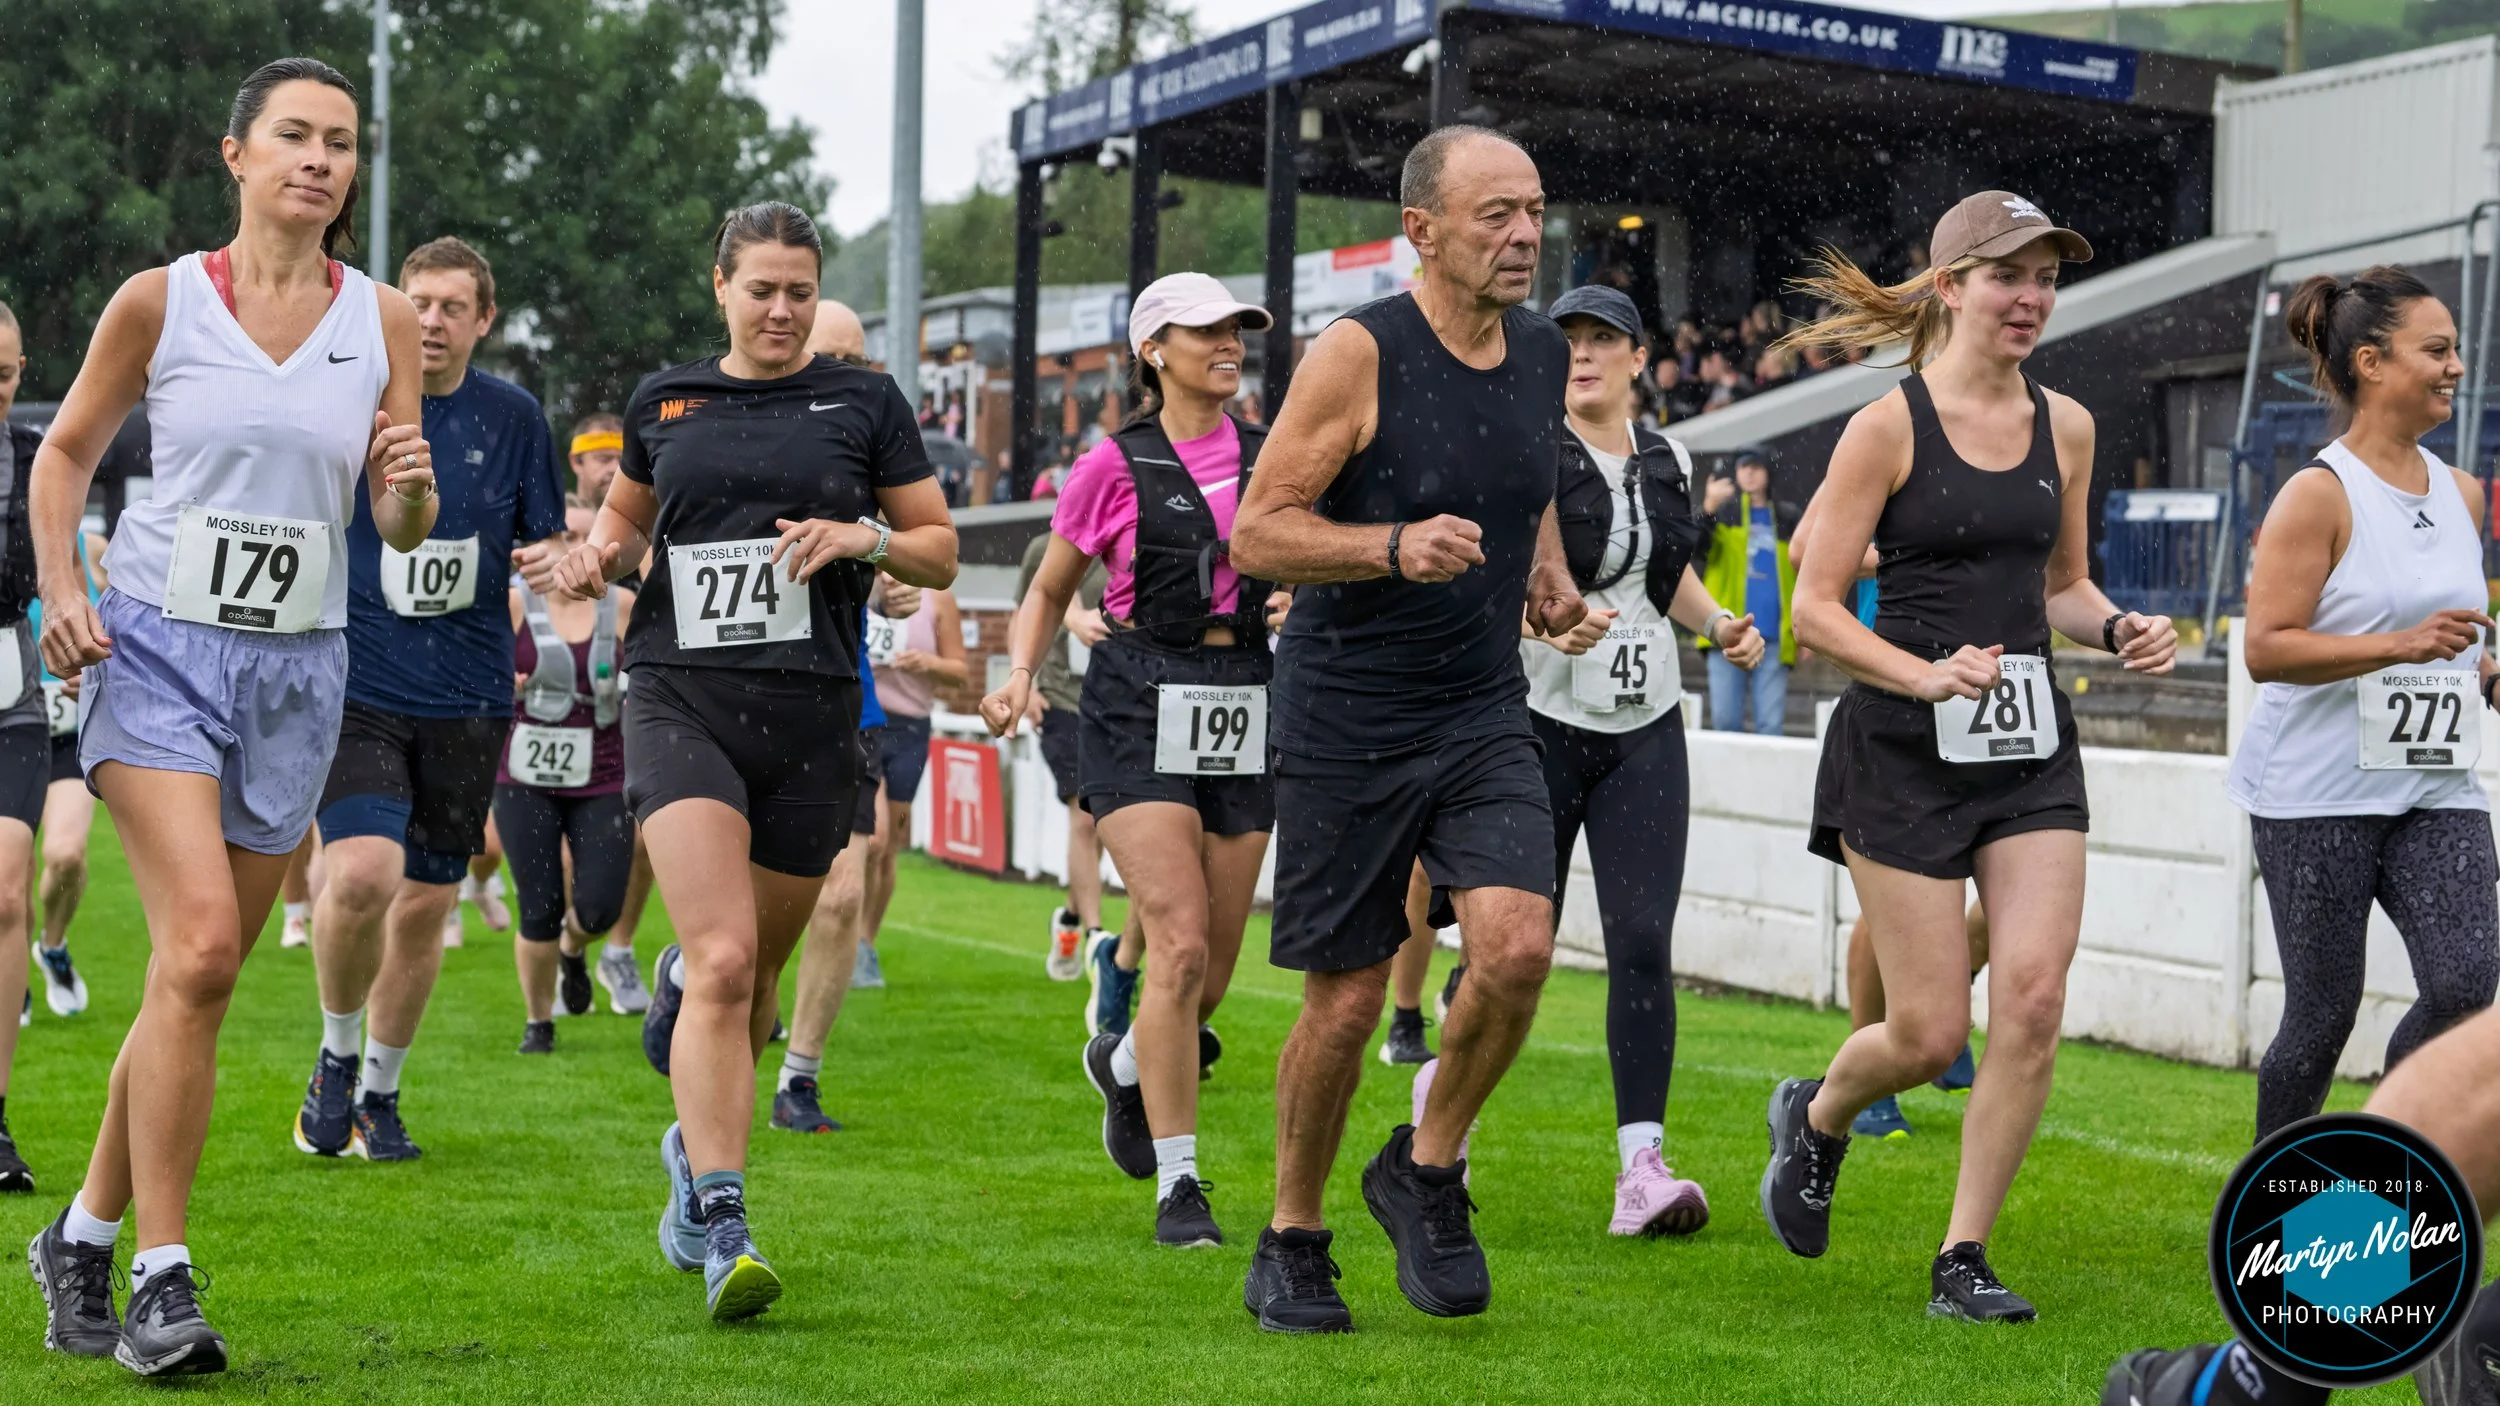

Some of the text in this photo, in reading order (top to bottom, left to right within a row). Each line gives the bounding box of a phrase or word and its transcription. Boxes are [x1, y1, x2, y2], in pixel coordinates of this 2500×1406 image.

[206, 516, 305, 539] MOSSLEY 10K
[210, 537, 299, 603] 179
[692, 546, 751, 561] MOSSLEY
[406, 556, 462, 595] 109
[696, 562, 780, 620] 274
[1604, 629, 1641, 639] OSSLEY
[1609, 644, 1647, 689] 45
[2020, 662, 2035, 672] 10K
[2382, 676, 2463, 687] MOSSLEY 10K
[1182, 690, 1252, 701] MOSSLEY 10K
[1968, 678, 2037, 734] 281
[1189, 706, 1249, 751] 199
[2387, 692, 2461, 743] 272
[527, 740, 574, 771] 242
